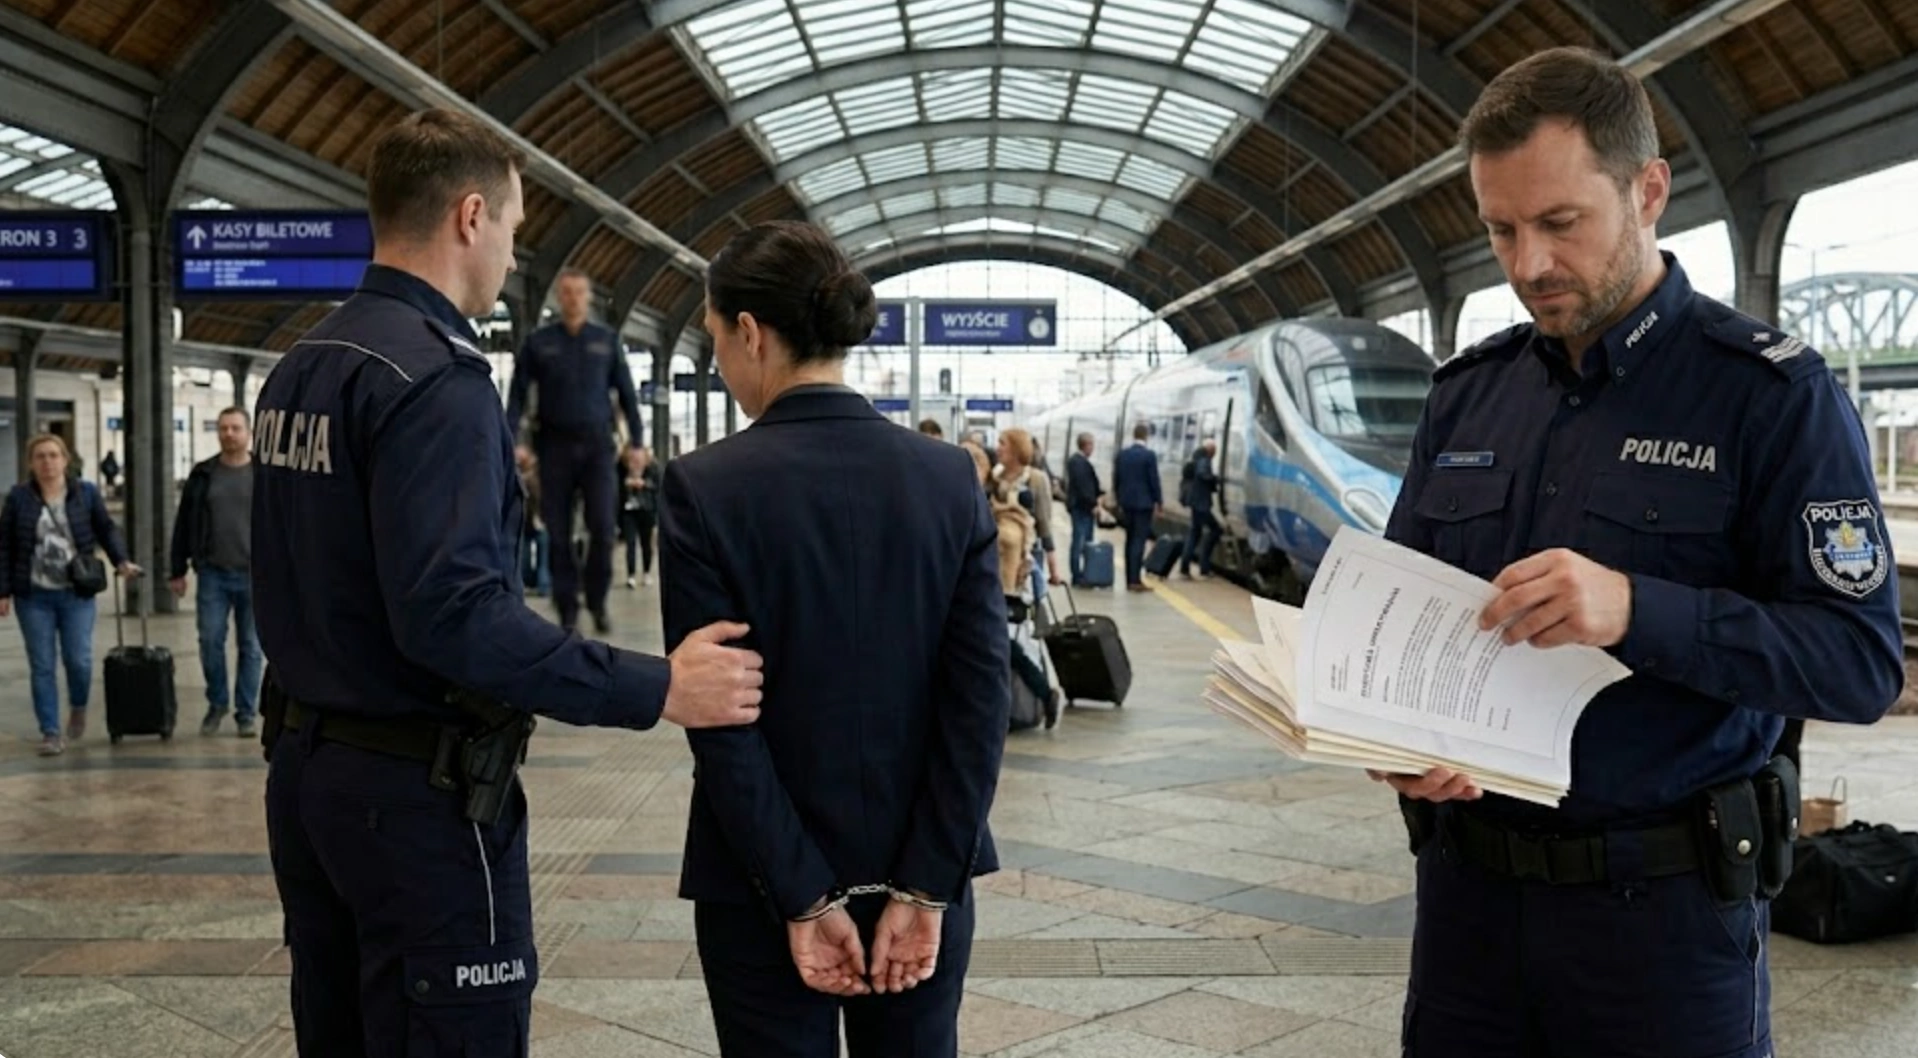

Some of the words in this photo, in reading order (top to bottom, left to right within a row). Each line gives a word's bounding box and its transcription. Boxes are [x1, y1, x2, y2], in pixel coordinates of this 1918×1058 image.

[0, 230, 40, 247] RON
[46, 229, 57, 247] 3
[73, 227, 88, 250] 3
[212, 222, 252, 238] KASY
[256, 221, 333, 238] BILETOWE
[1619, 438, 1716, 472] POLICJA
[456, 958, 526, 988] POLICJA
